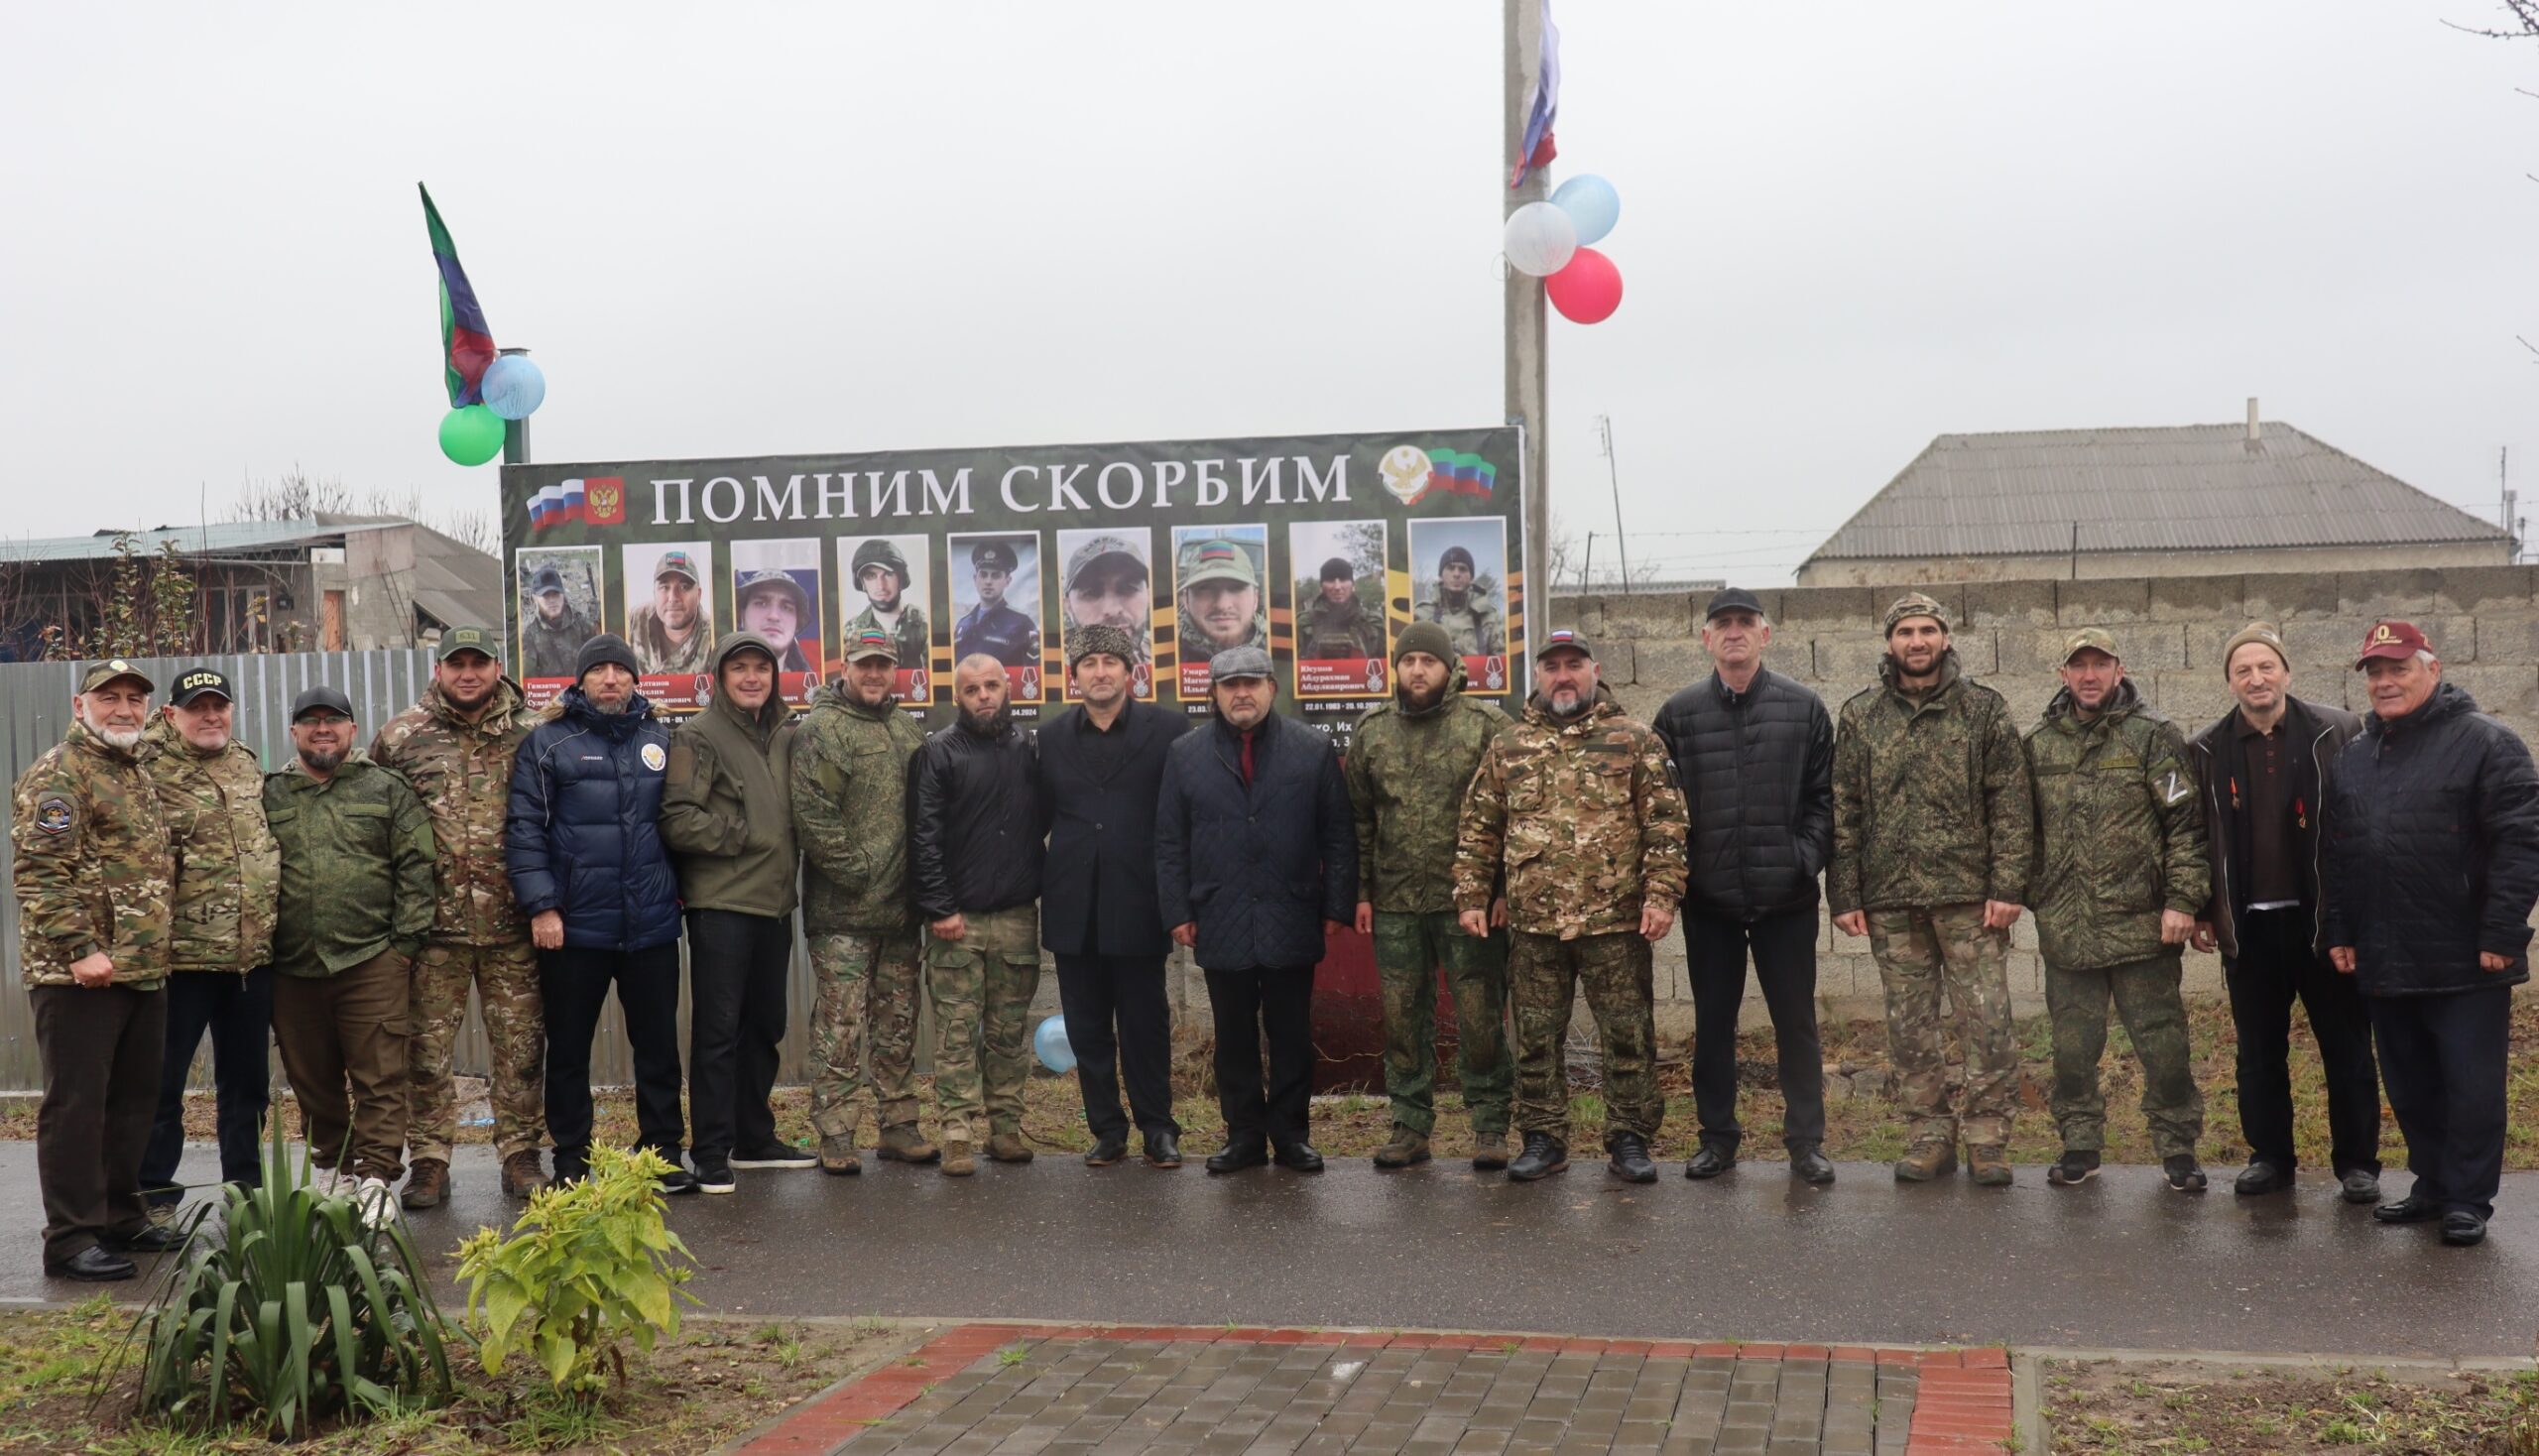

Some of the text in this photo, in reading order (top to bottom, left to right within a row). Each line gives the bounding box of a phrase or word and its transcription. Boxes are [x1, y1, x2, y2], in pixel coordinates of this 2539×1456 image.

[650, 454, 1353, 526] ПОМНИМ СКОРБИМ
[1182, 667, 1209, 676] Умаро
[182, 672, 222, 690] СССР
[527, 698, 550, 708] Сулей
[1337, 721, 1352, 732] Их
